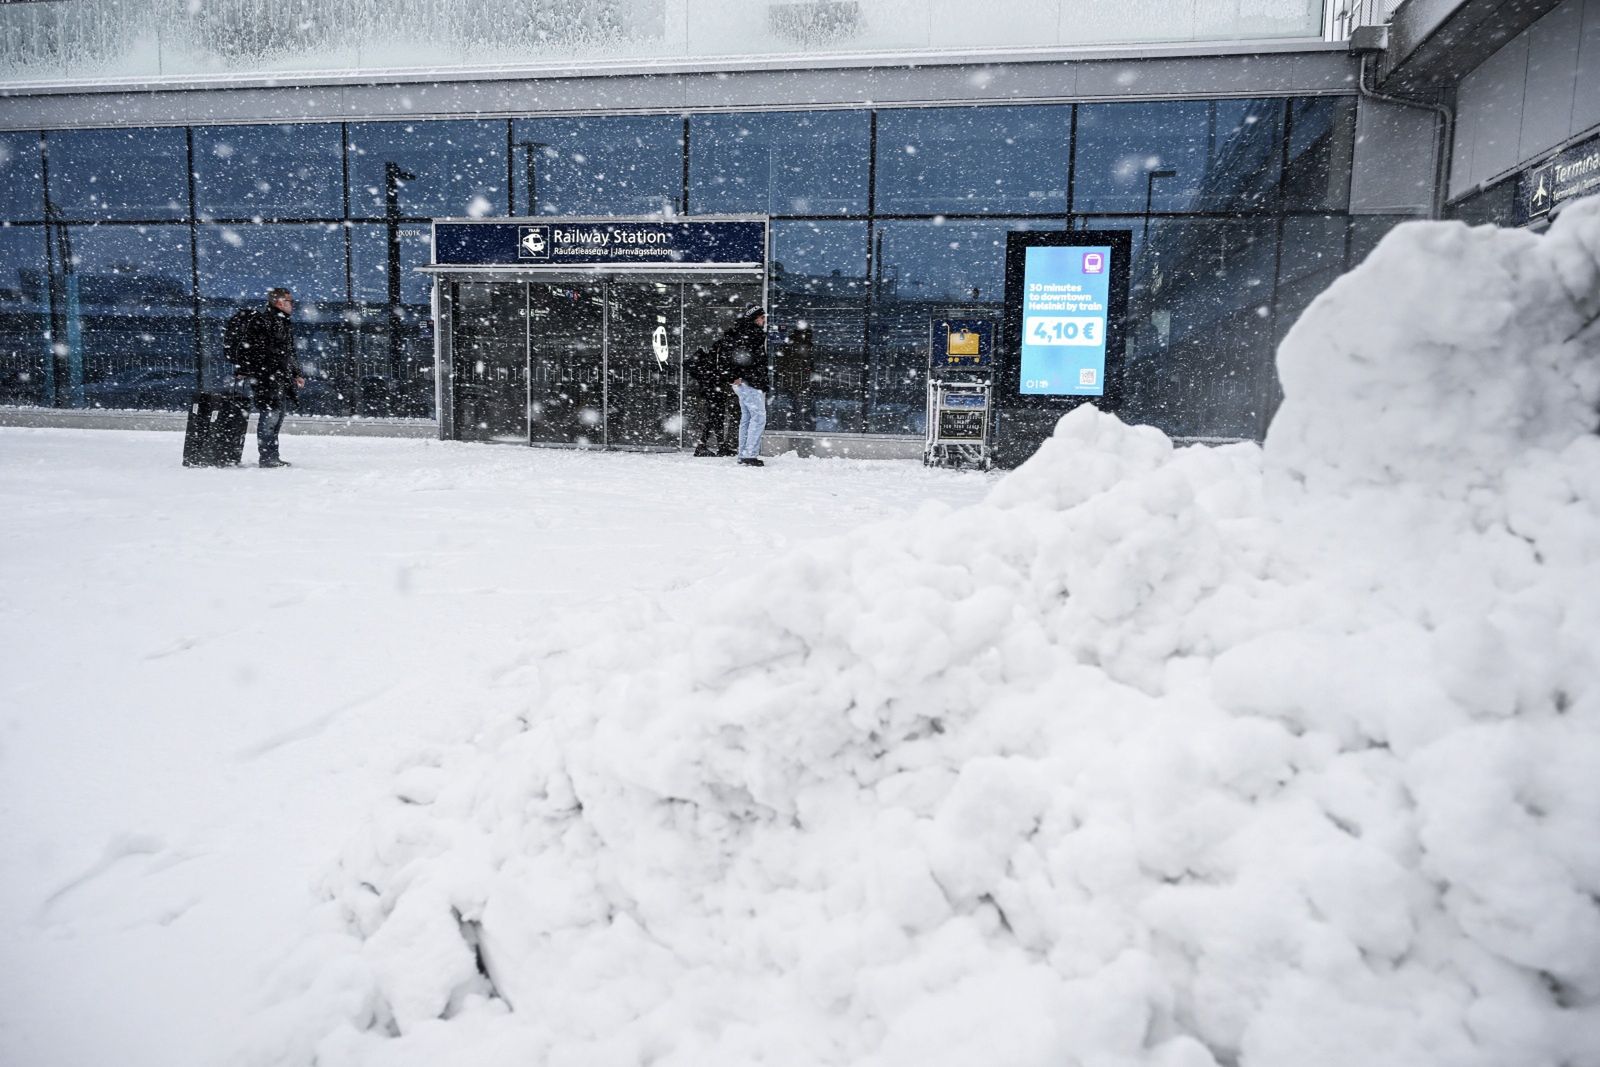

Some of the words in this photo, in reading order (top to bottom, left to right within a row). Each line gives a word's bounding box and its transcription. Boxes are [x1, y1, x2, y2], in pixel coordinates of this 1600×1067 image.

[1554, 151, 1600, 183] Termina
[553, 229, 610, 247] Railway
[613, 229, 667, 244] Station
[553, 247, 609, 256] Rautatieasema
[614, 247, 673, 256] Järnvägsstation
[1028, 283, 1043, 292] 30
[1043, 283, 1082, 292] minutes
[1028, 293, 1040, 301] to
[1040, 293, 1092, 302] downtown
[1028, 302, 1066, 311] Helsinki
[1066, 302, 1078, 313] by
[1079, 302, 1103, 311] train
[1033, 322, 1079, 343] 4,10
[1082, 322, 1095, 340] €
